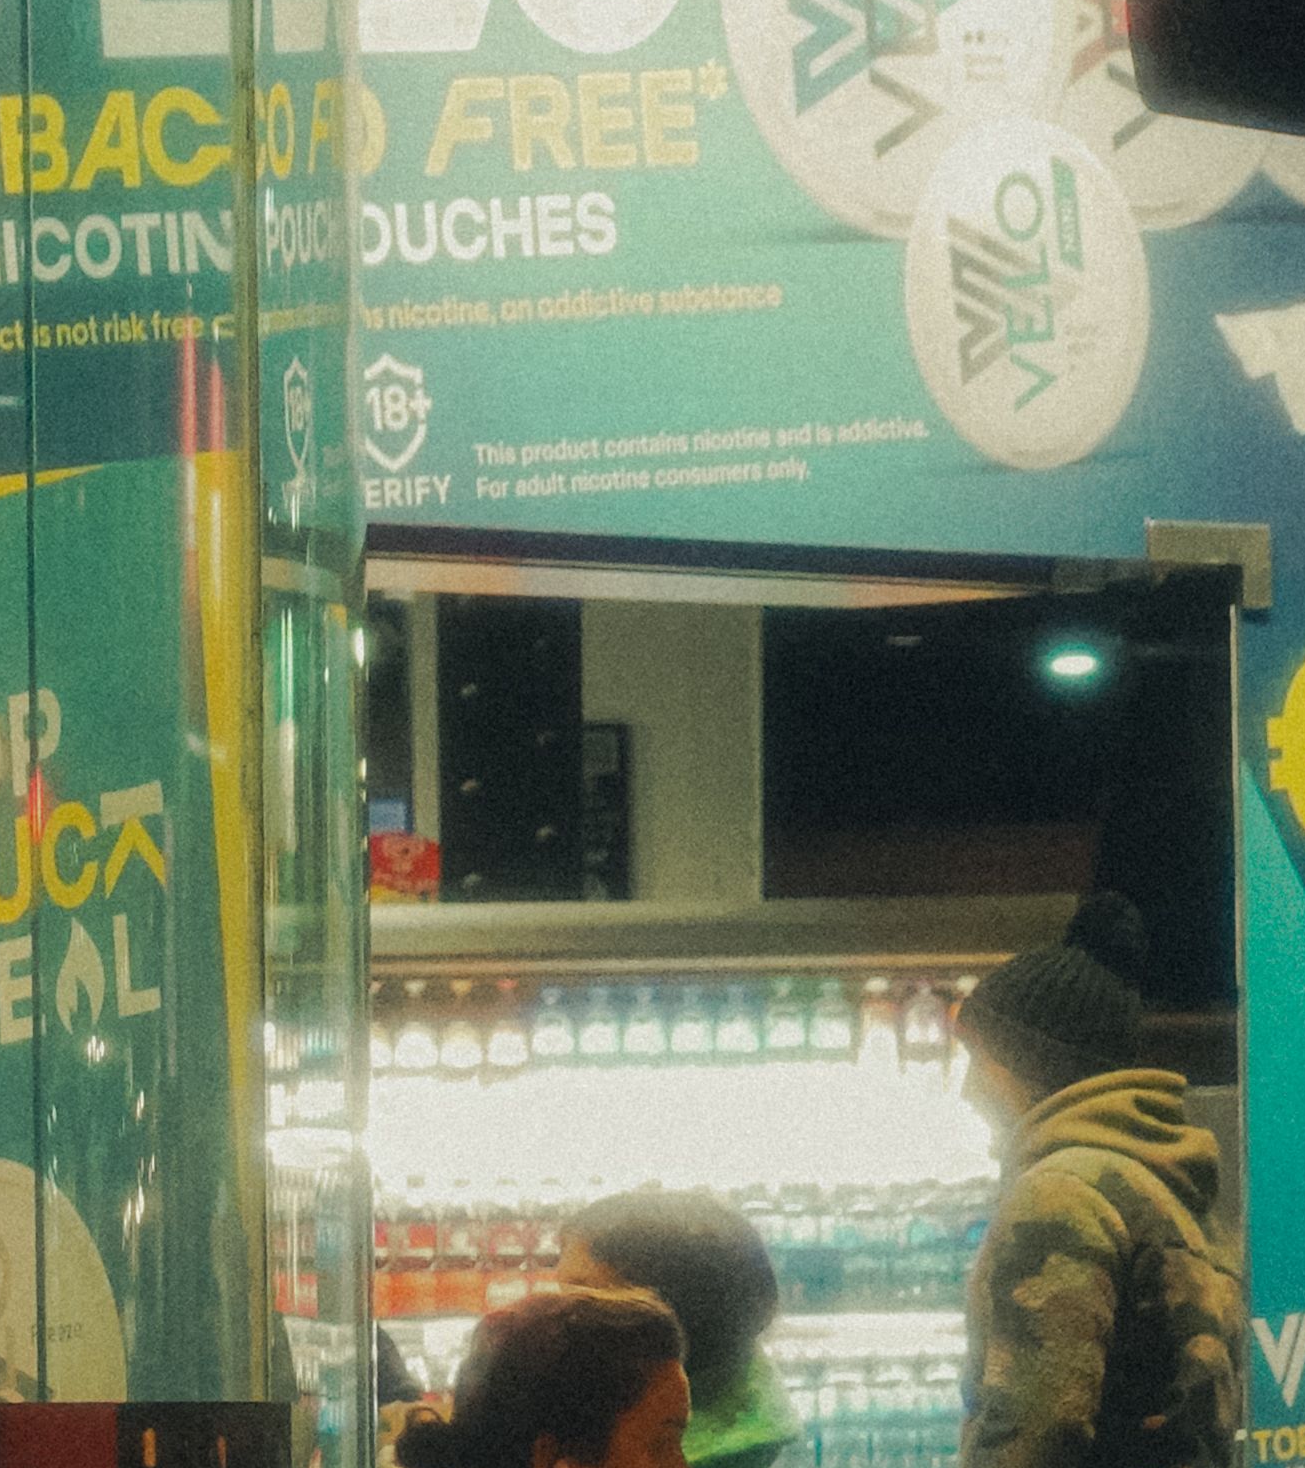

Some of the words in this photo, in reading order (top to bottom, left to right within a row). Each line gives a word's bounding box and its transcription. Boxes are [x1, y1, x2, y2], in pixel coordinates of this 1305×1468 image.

[32, 319, 52, 348] is
[56, 315, 100, 347] not
[103, 311, 147, 344] risk
[364, 383, 433, 432] 18+
[474, 441, 516, 468] This
[521, 435, 598, 471] product
[603, 431, 689, 460] contains
[693, 425, 772, 453] nicotine
[776, 420, 811, 446] and
[816, 420, 833, 445] is
[363, 474, 452, 510] ERIFY
[476, 476, 507, 501] For
[515, 471, 565, 498] adult
[571, 467, 651, 493] nicotine
[654, 459, 762, 490] consumers
